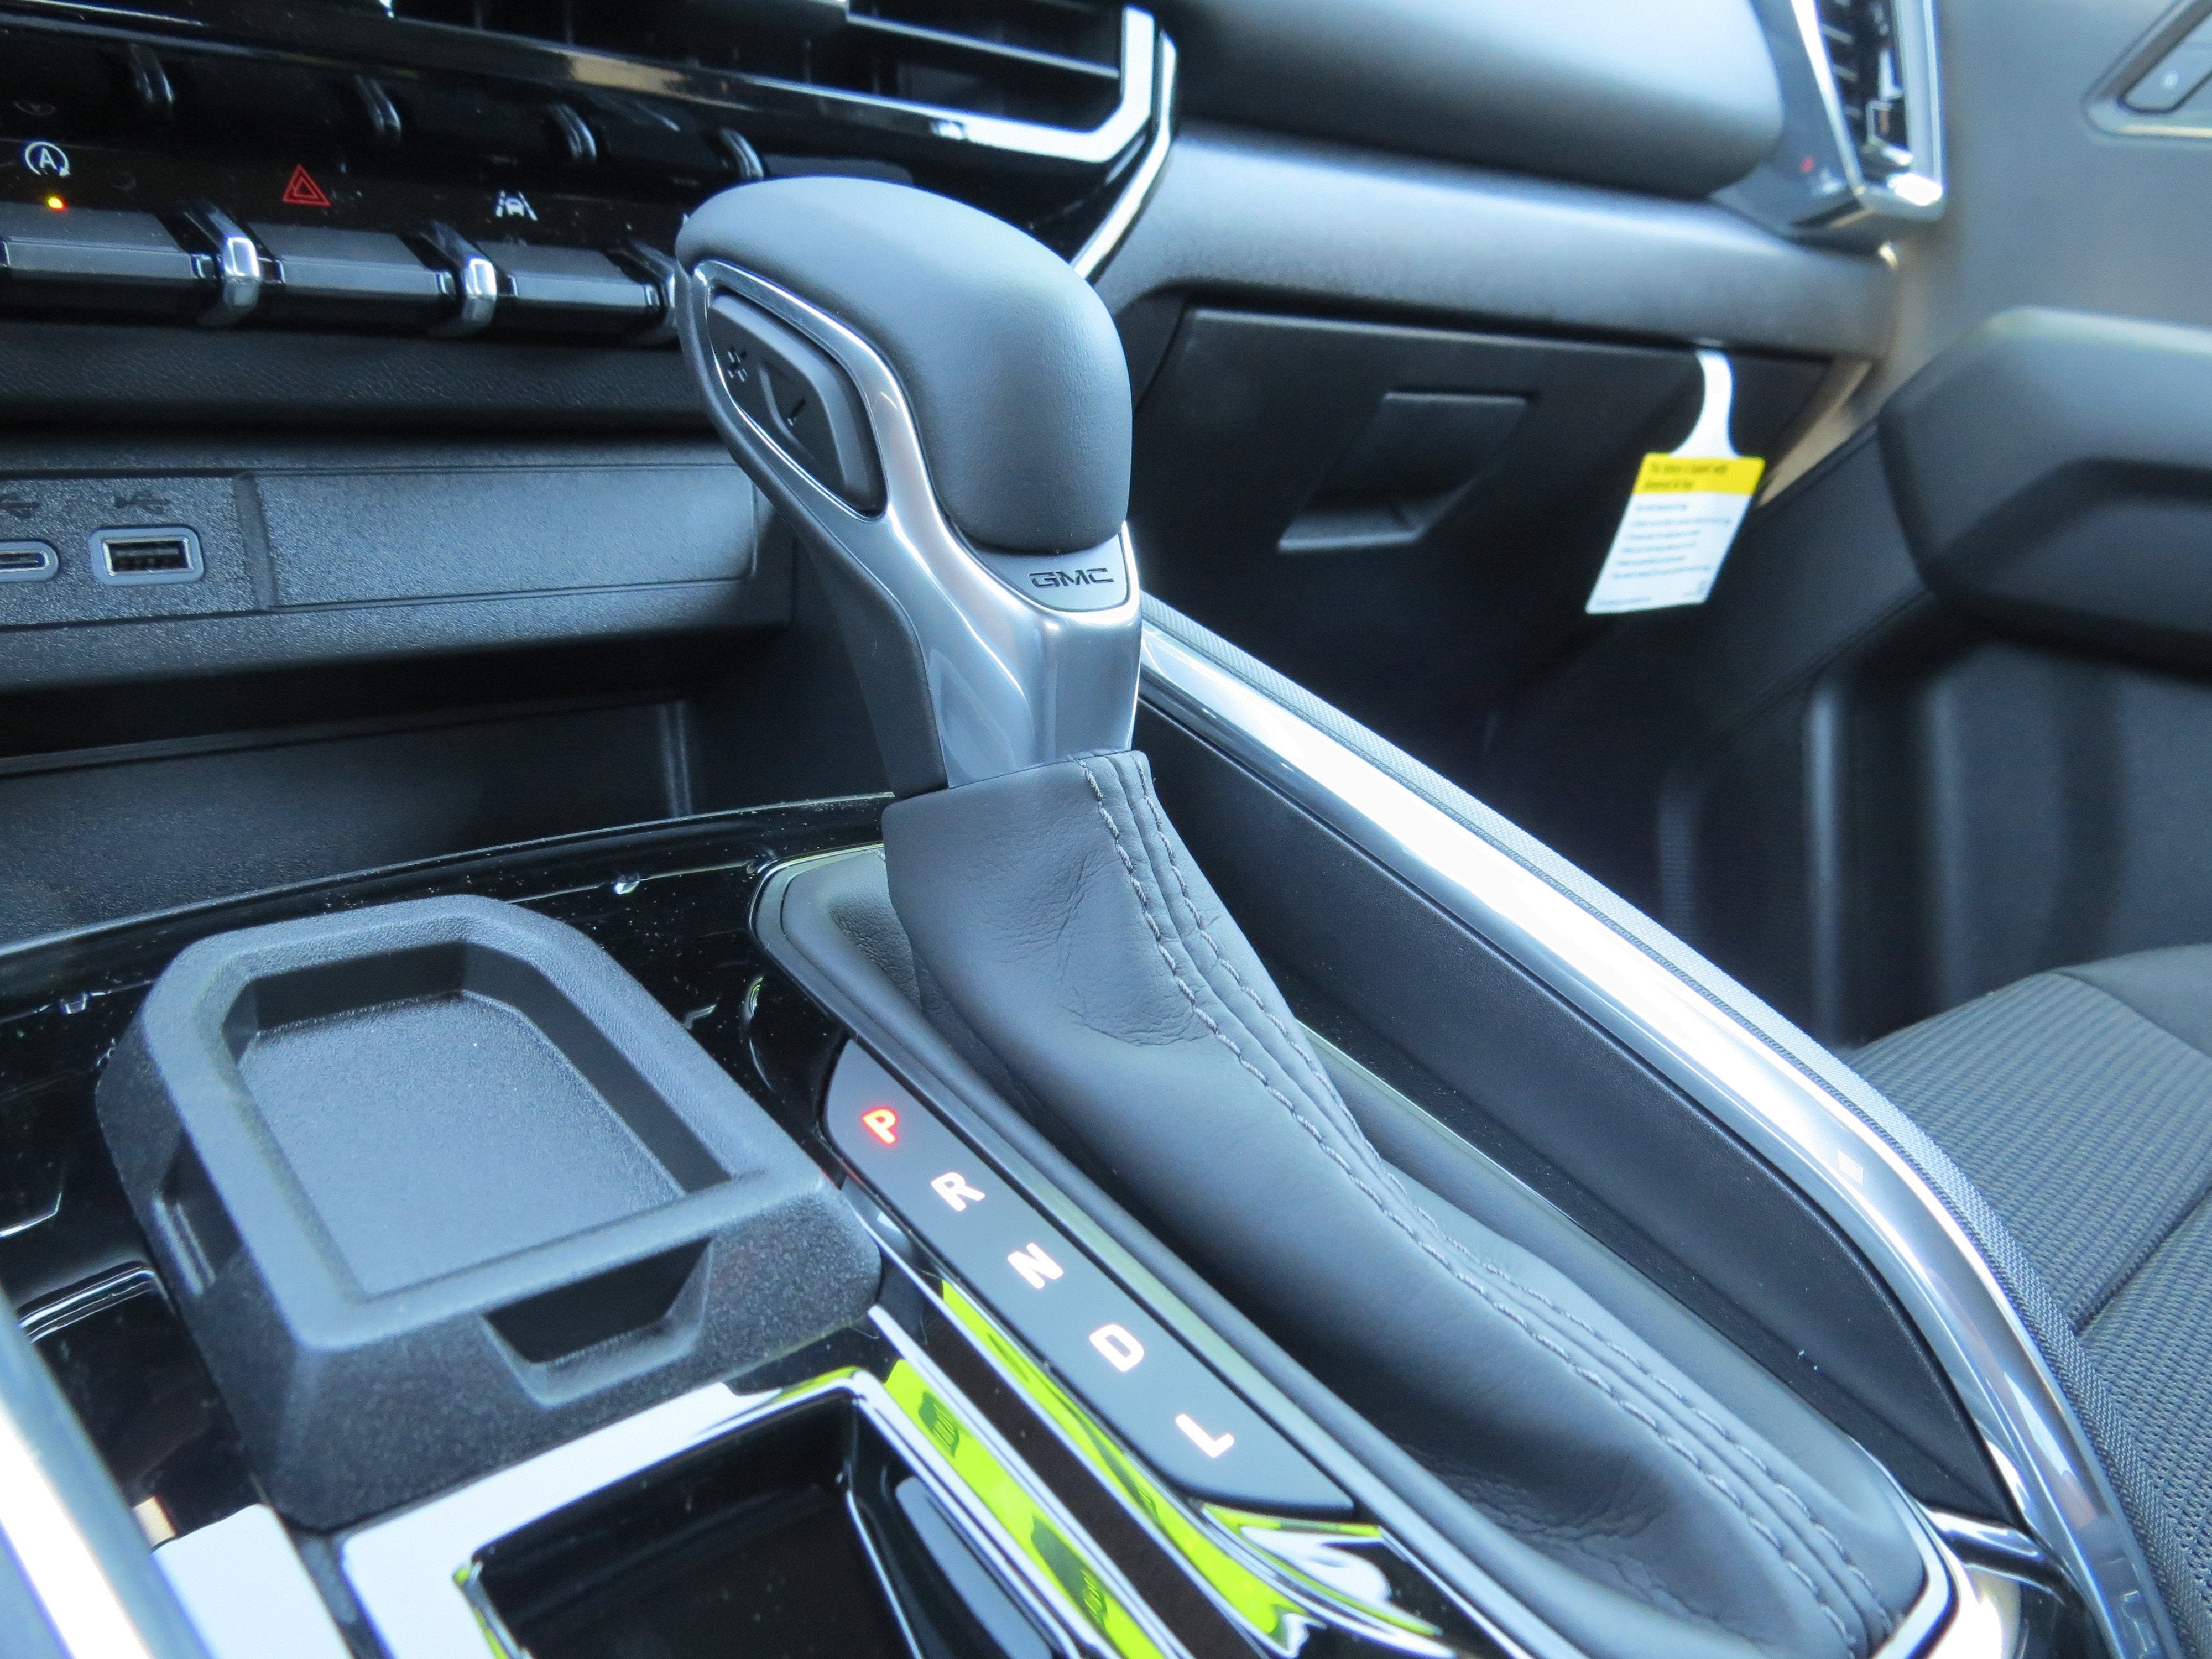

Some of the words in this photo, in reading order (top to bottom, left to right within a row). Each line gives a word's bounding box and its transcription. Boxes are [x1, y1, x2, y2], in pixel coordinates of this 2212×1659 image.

[40, 147, 58, 170] A
[1029, 568, 1114, 588] GMC
[862, 1107, 898, 1145] P
[931, 1172, 985, 1211] R
[1007, 1242, 1064, 1289] N
[1089, 1324, 1144, 1372] D
[1175, 1413, 1234, 1458] L
